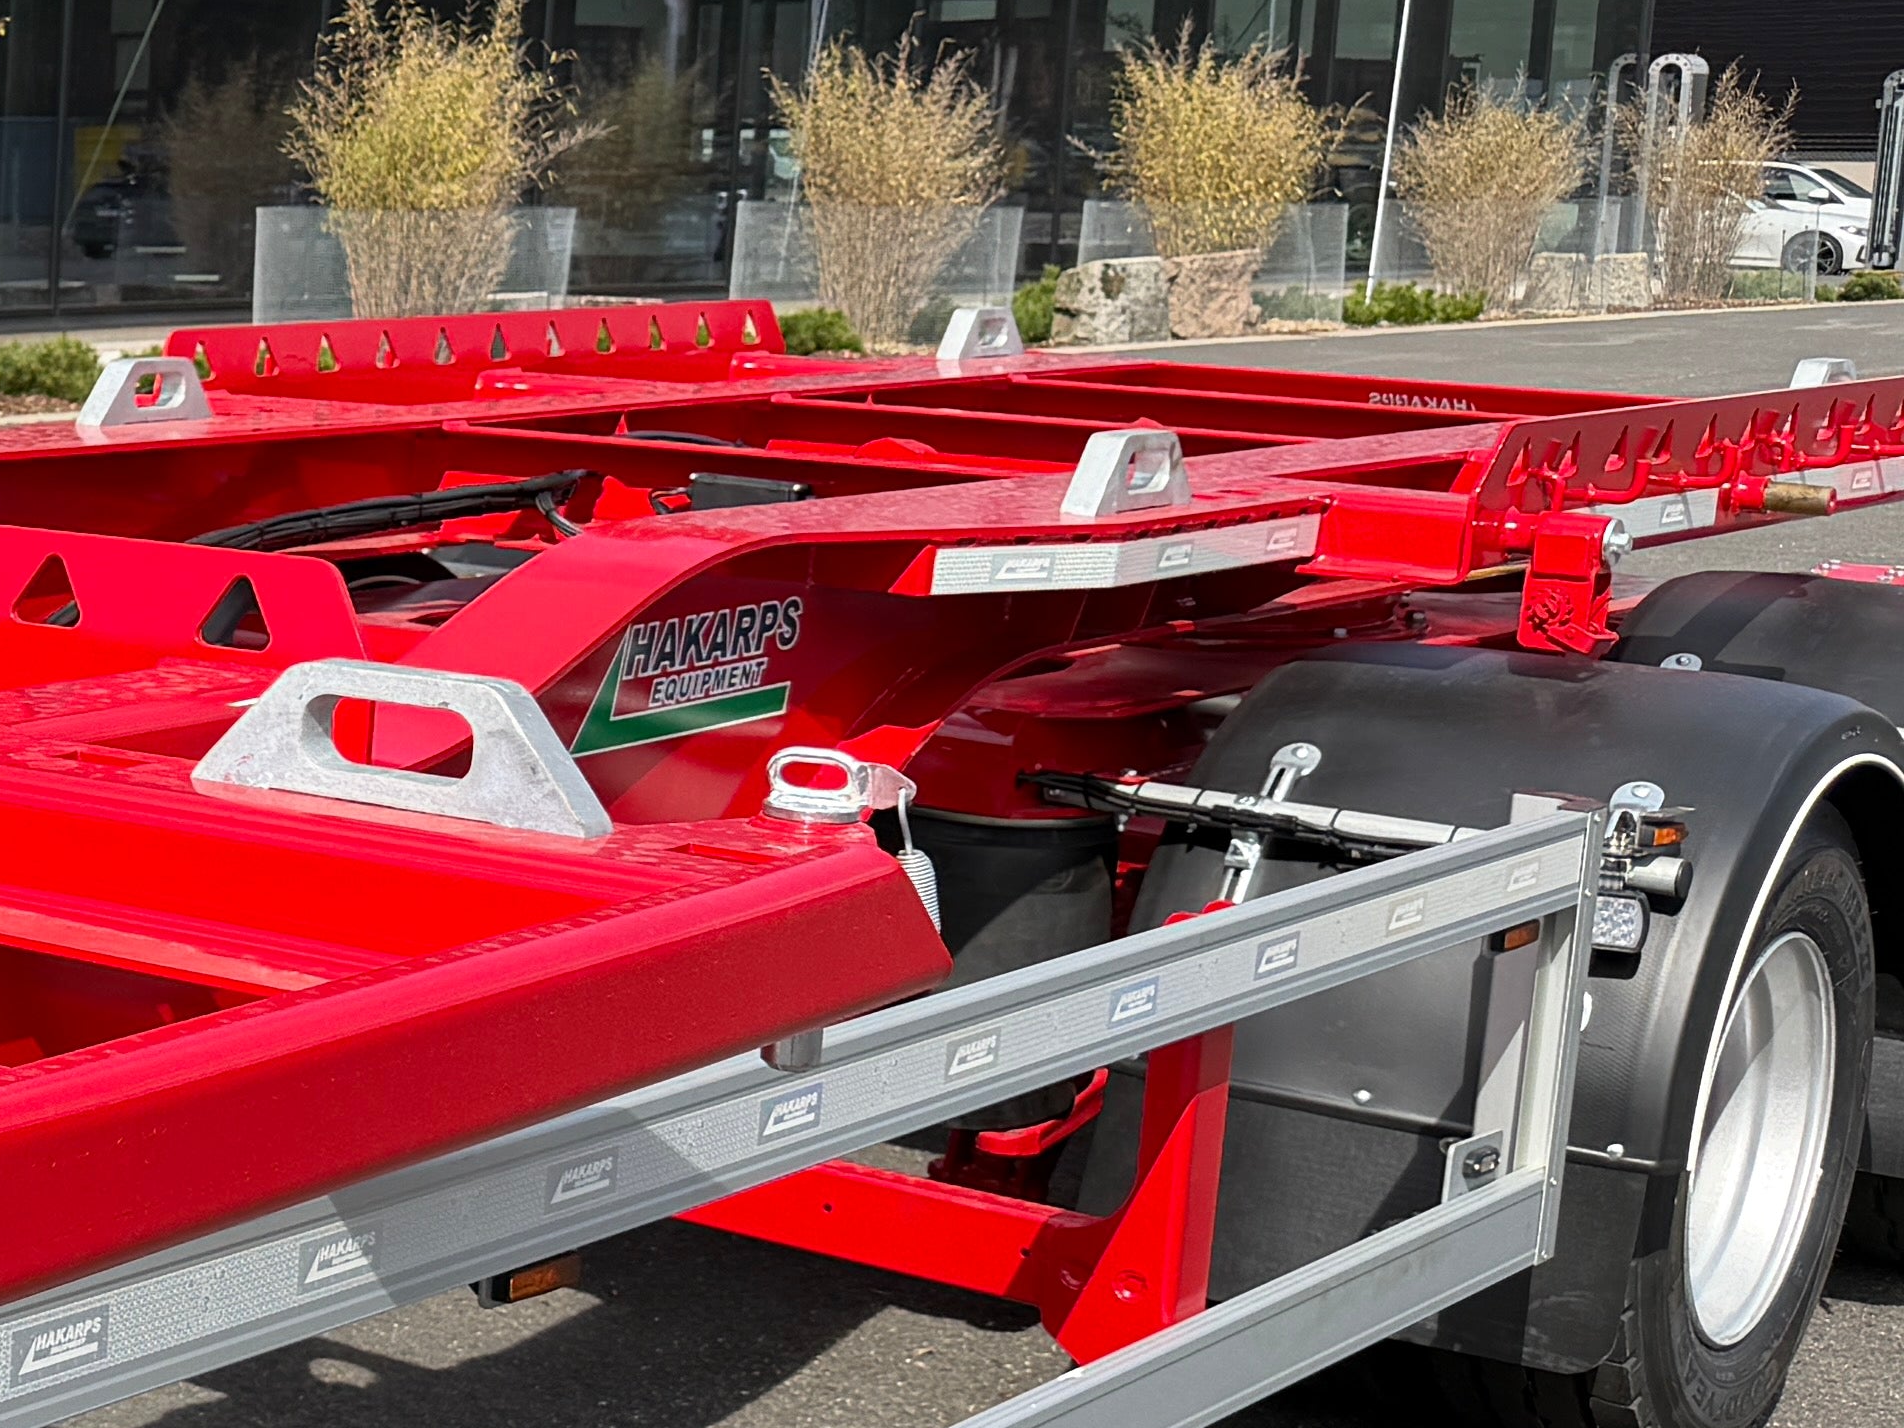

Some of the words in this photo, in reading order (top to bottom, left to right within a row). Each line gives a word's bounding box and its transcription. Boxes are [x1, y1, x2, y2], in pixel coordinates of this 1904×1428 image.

[622, 595, 804, 680] HAKARPS
[648, 656, 770, 708] EQUIPMENT
[35, 1317, 102, 1351] HAKARPS
